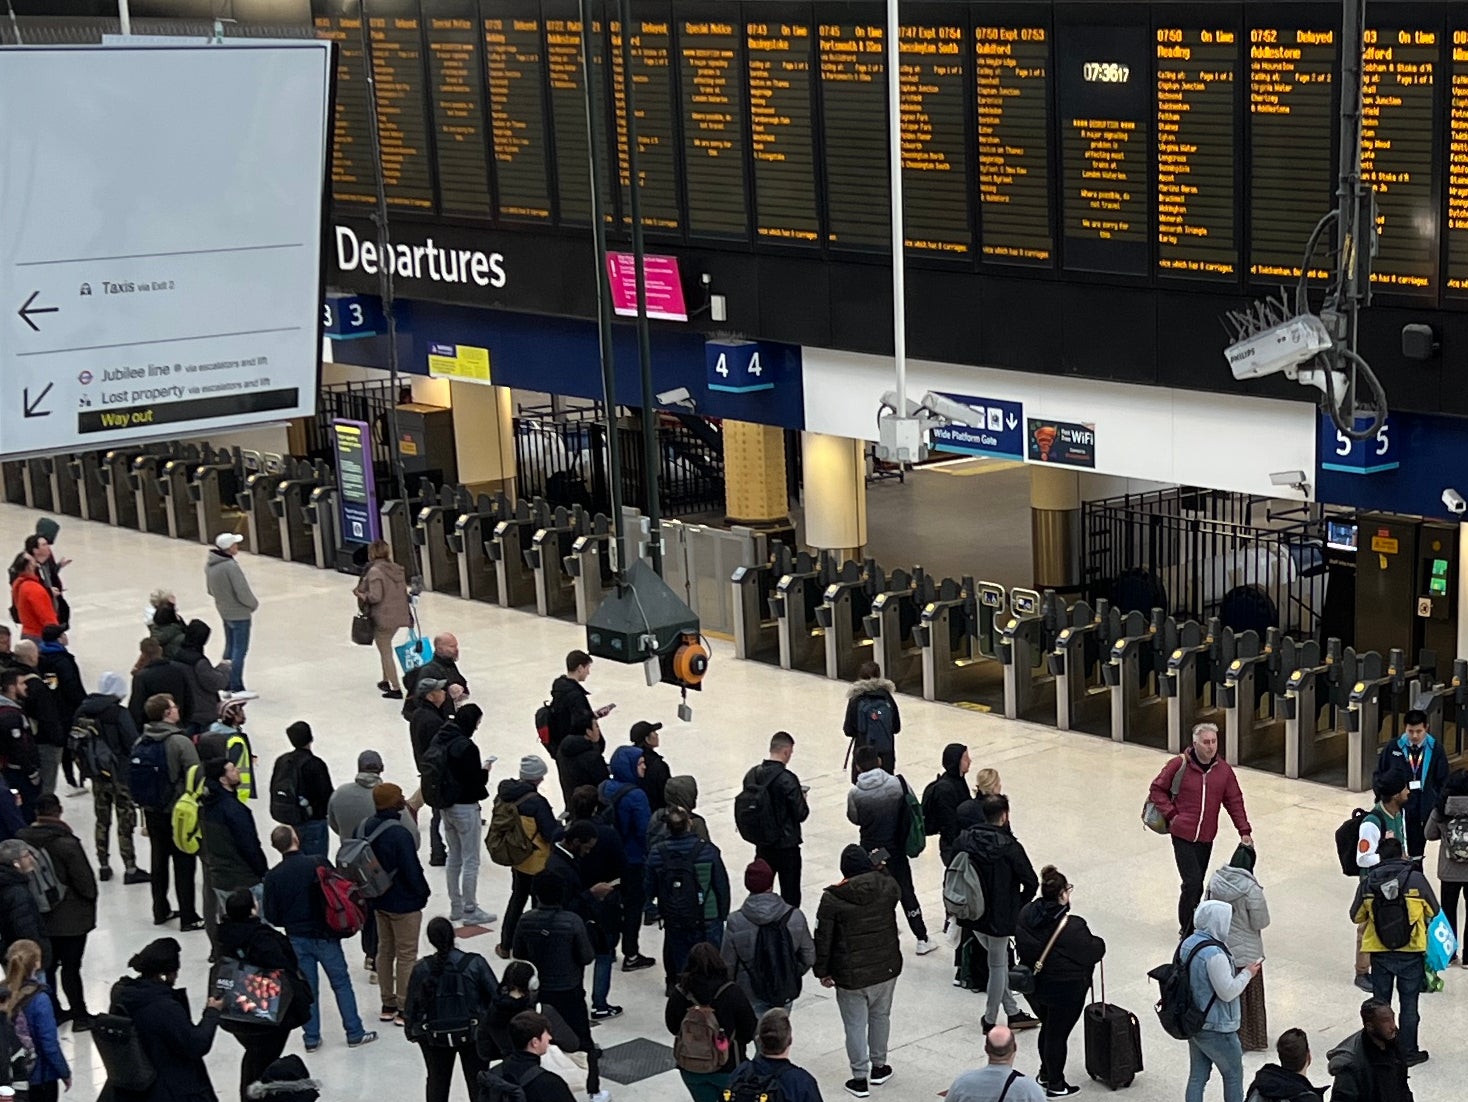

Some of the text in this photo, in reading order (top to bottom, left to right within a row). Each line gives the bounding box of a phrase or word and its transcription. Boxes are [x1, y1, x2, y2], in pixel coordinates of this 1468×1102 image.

[1296, 30, 1333, 45] Delayed
[335, 225, 506, 288] Departures
[102, 280, 175, 296] Taxis via Exit 2
[349, 303, 364, 326] 3
[715, 353, 729, 378] 4
[748, 352, 762, 377] 4
[1230, 347, 1255, 364] PHILIPS
[101, 356, 267, 382] Jubilee line via escalators and lift
[101, 377, 271, 405] Lost property via escalators and lift
[101, 410, 154, 429] Way out
[933, 428, 997, 446] Wide Platform Gate
[1071, 429, 1094, 446] WiFi
[1336, 427, 1352, 456] 5
[1375, 425, 1389, 455] 5
